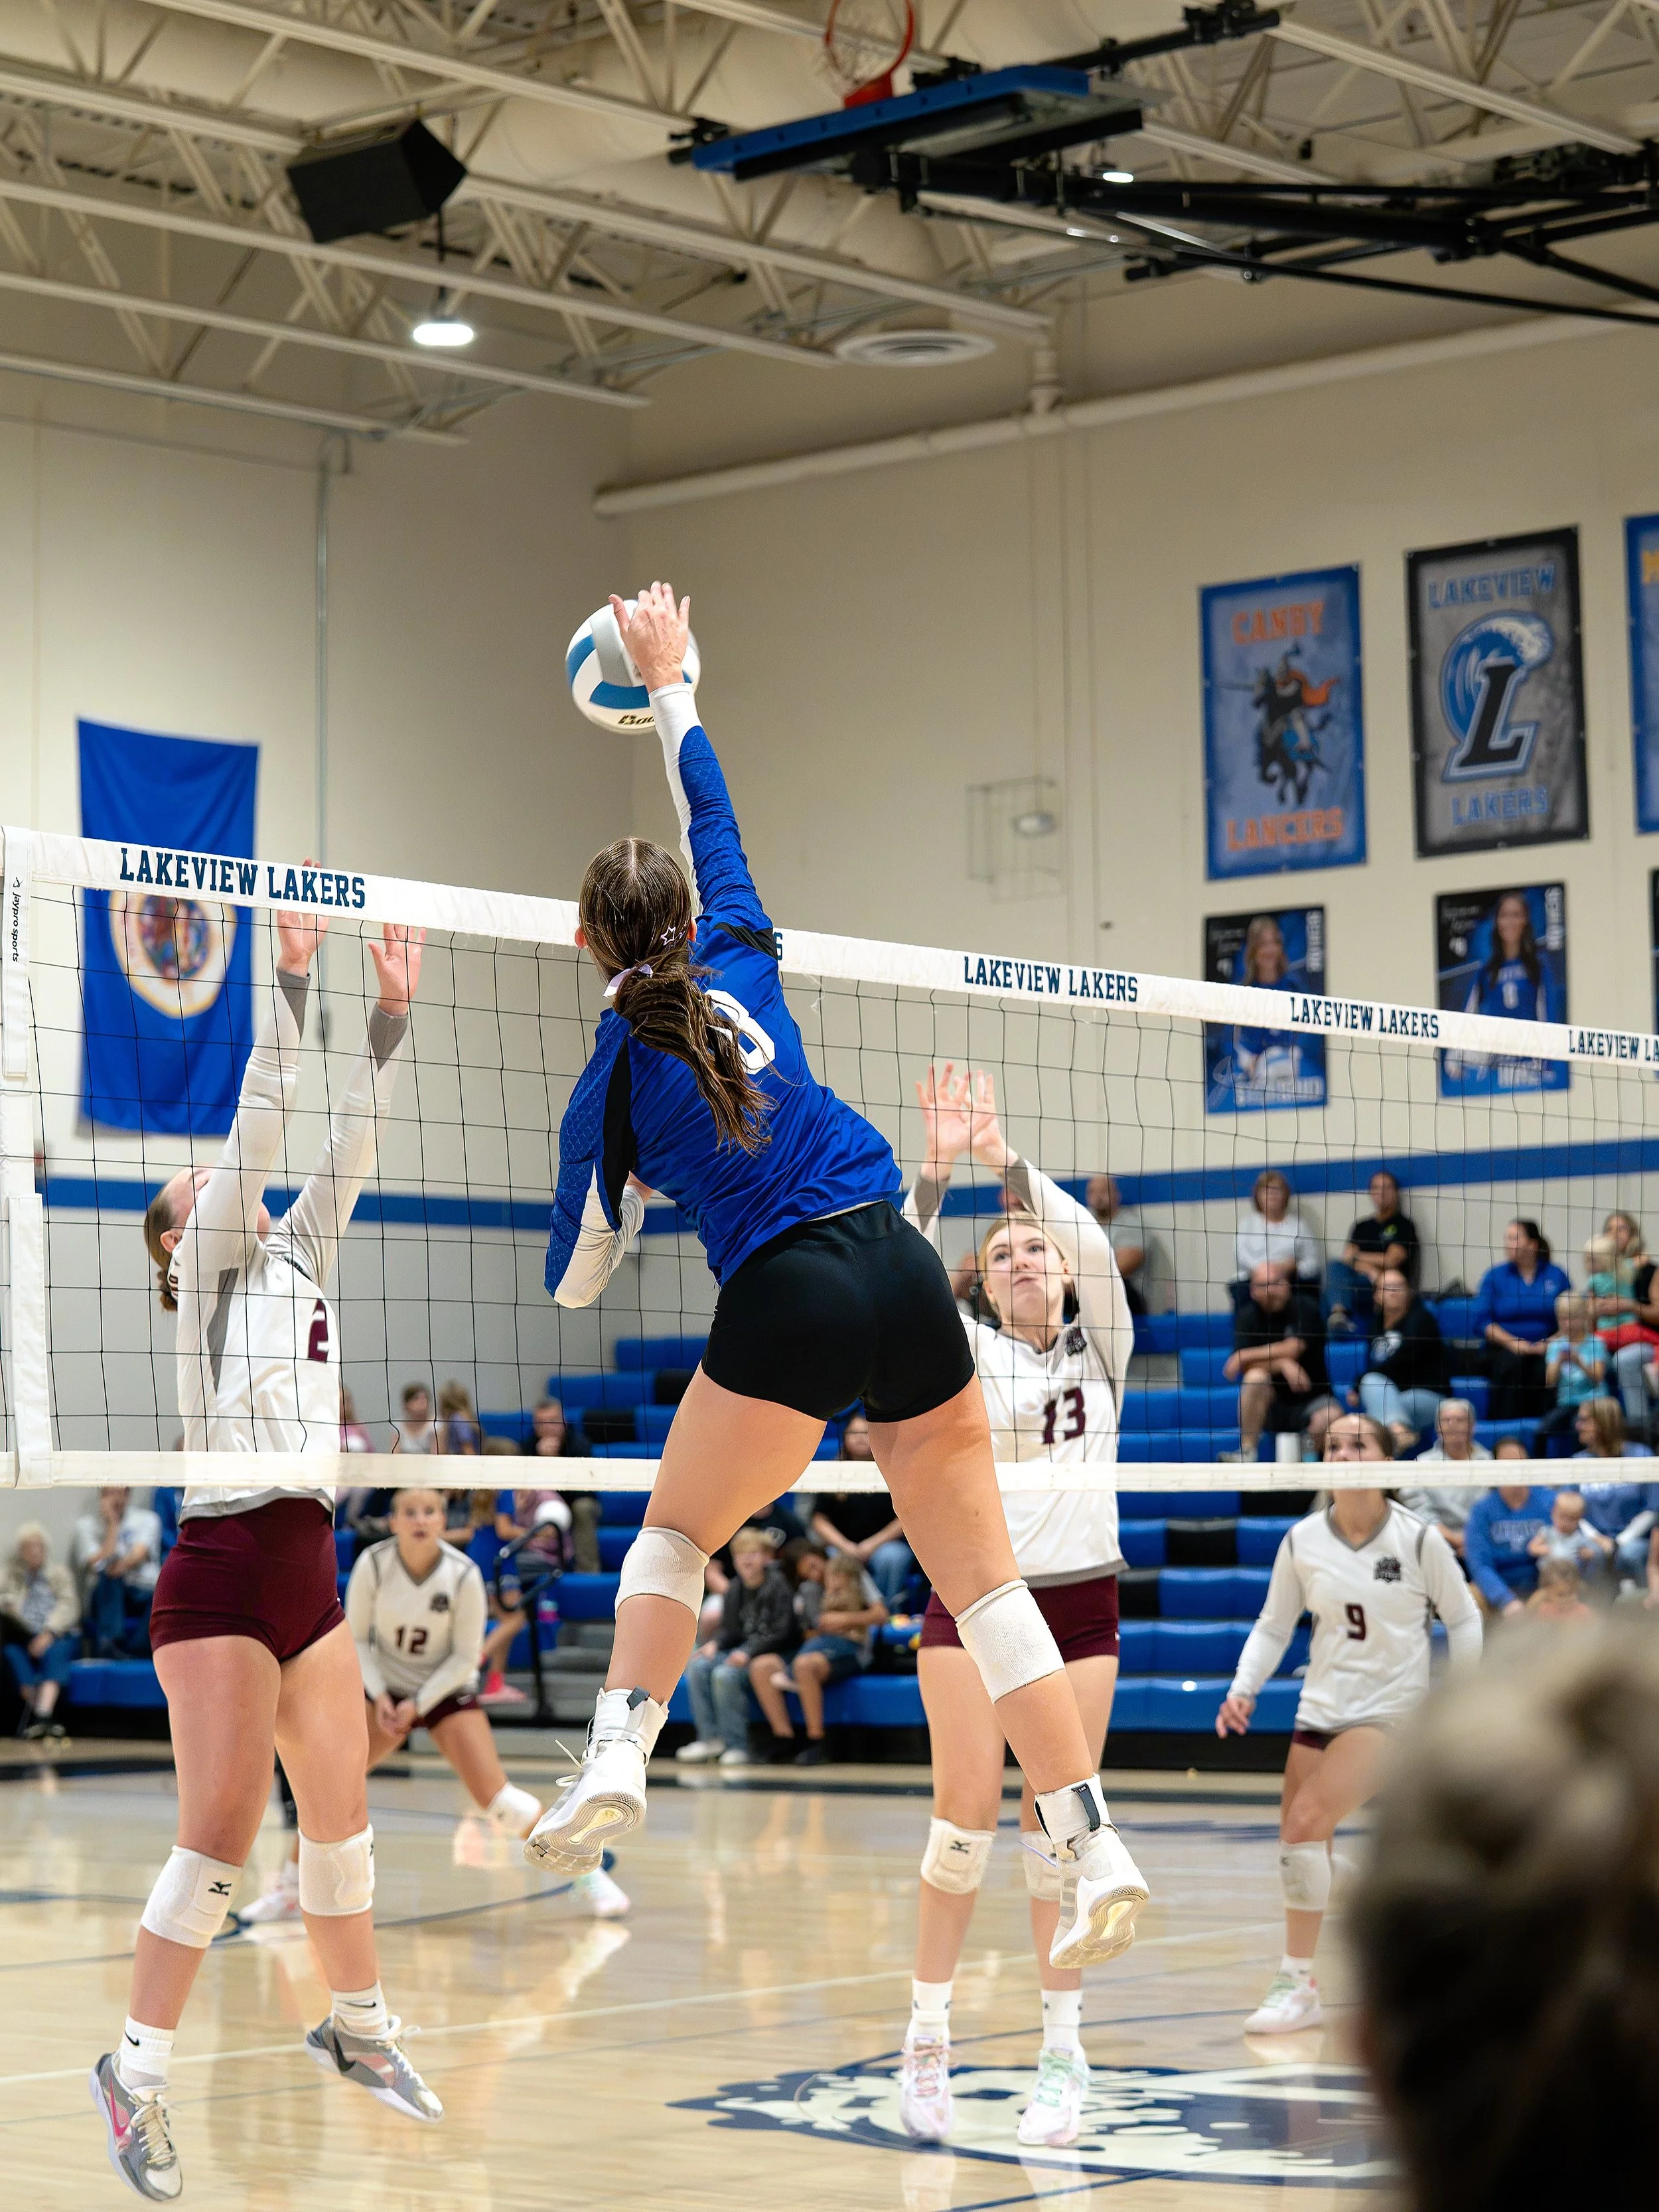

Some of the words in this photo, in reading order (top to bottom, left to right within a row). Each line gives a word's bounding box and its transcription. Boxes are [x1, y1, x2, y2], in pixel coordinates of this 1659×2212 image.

[1428, 562, 1556, 609] LAKEVIEW
[1452, 785, 1550, 826] LAKERS
[119, 848, 257, 896] LAKEVIEW
[267, 866, 365, 909] LAKERS
[964, 956, 1060, 994] LAKEVIEW
[1069, 969, 1137, 1002] LAKERS
[1290, 997, 1373, 1031] LAKEVIEW
[1378, 1008, 1439, 1038] LAKERS
[1569, 1029, 1639, 1059] LAKEVIEW
[1041, 1386, 1086, 1445] 13
[395, 1625, 428, 1655] 12
[1345, 1603, 1366, 1641] 9
